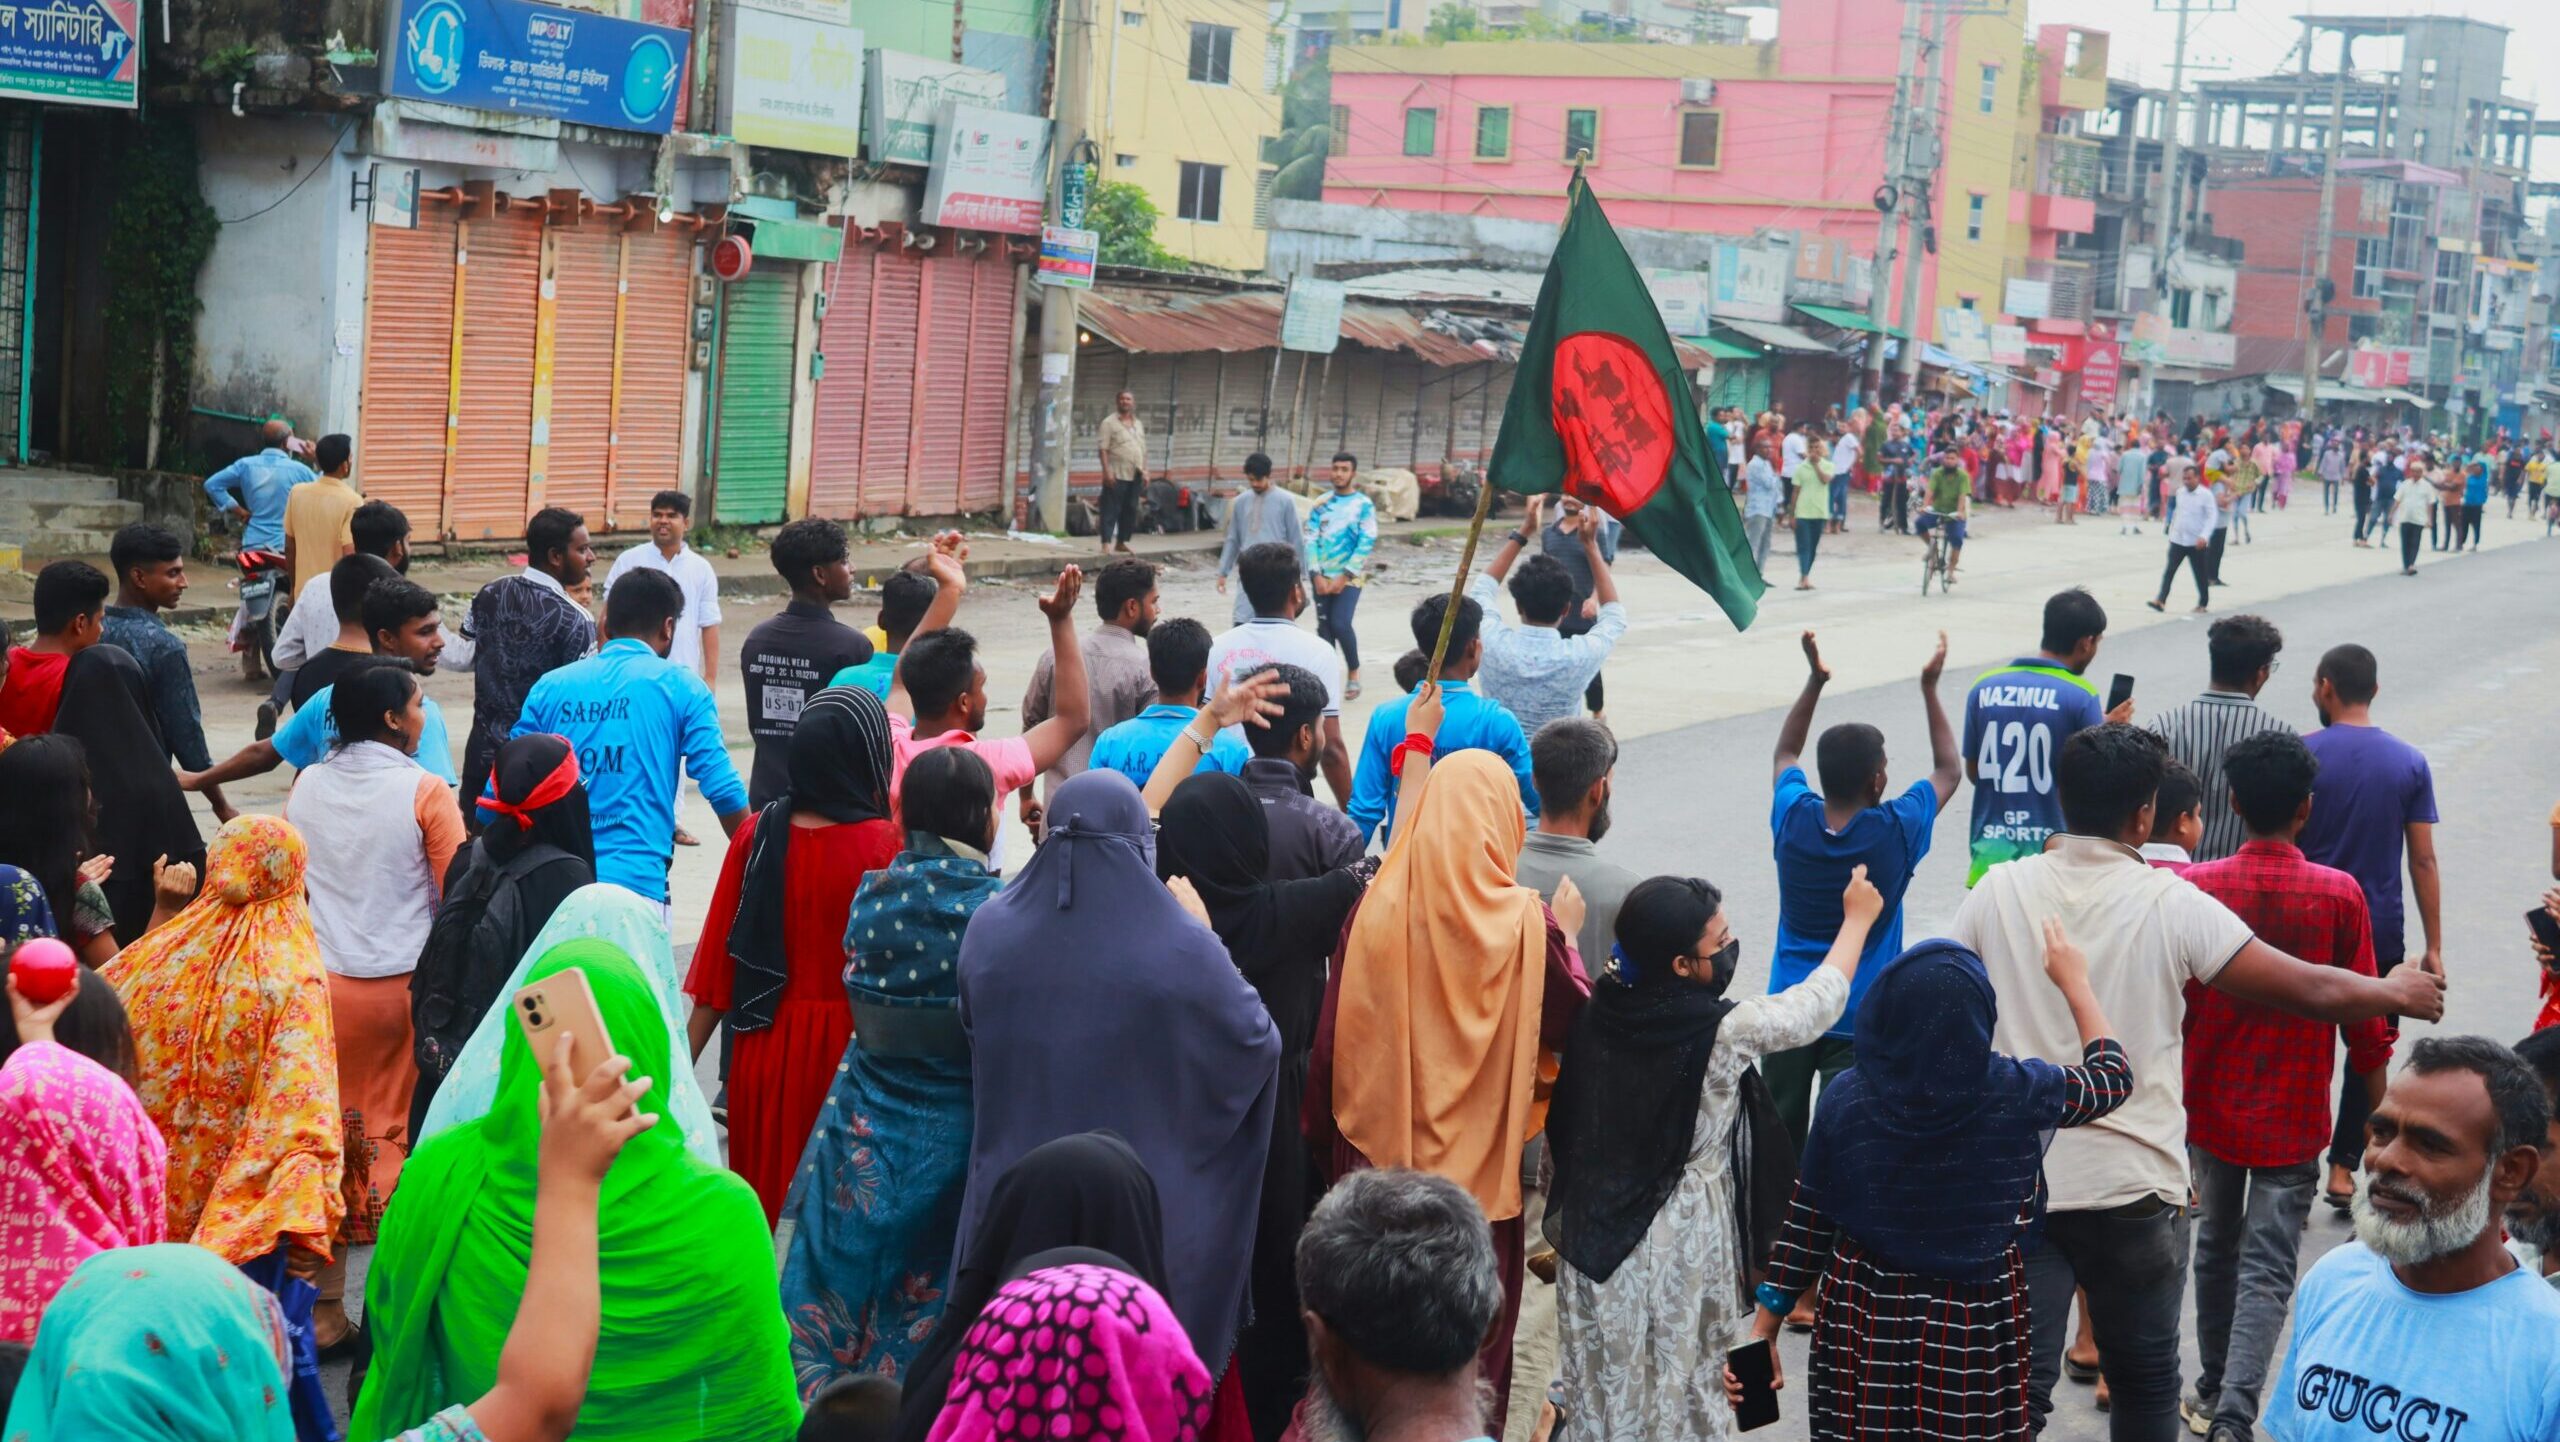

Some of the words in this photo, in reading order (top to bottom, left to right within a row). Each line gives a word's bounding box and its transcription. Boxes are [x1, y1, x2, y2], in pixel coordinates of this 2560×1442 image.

[22, 0, 104, 47] স্যানিটারি
[530, 20, 571, 41] NPOLY
[758, 654, 790, 666] ORIGINAL
[791, 658, 810, 668] WEAR
[765, 697, 802, 712] US-07
[1979, 686, 2060, 710] NAZMUL
[1977, 720, 2053, 795] 420
[2004, 810, 2030, 826] GP
[1982, 824, 2055, 842] SPORTS
[2297, 1363, 2469, 1442] GUCCI
